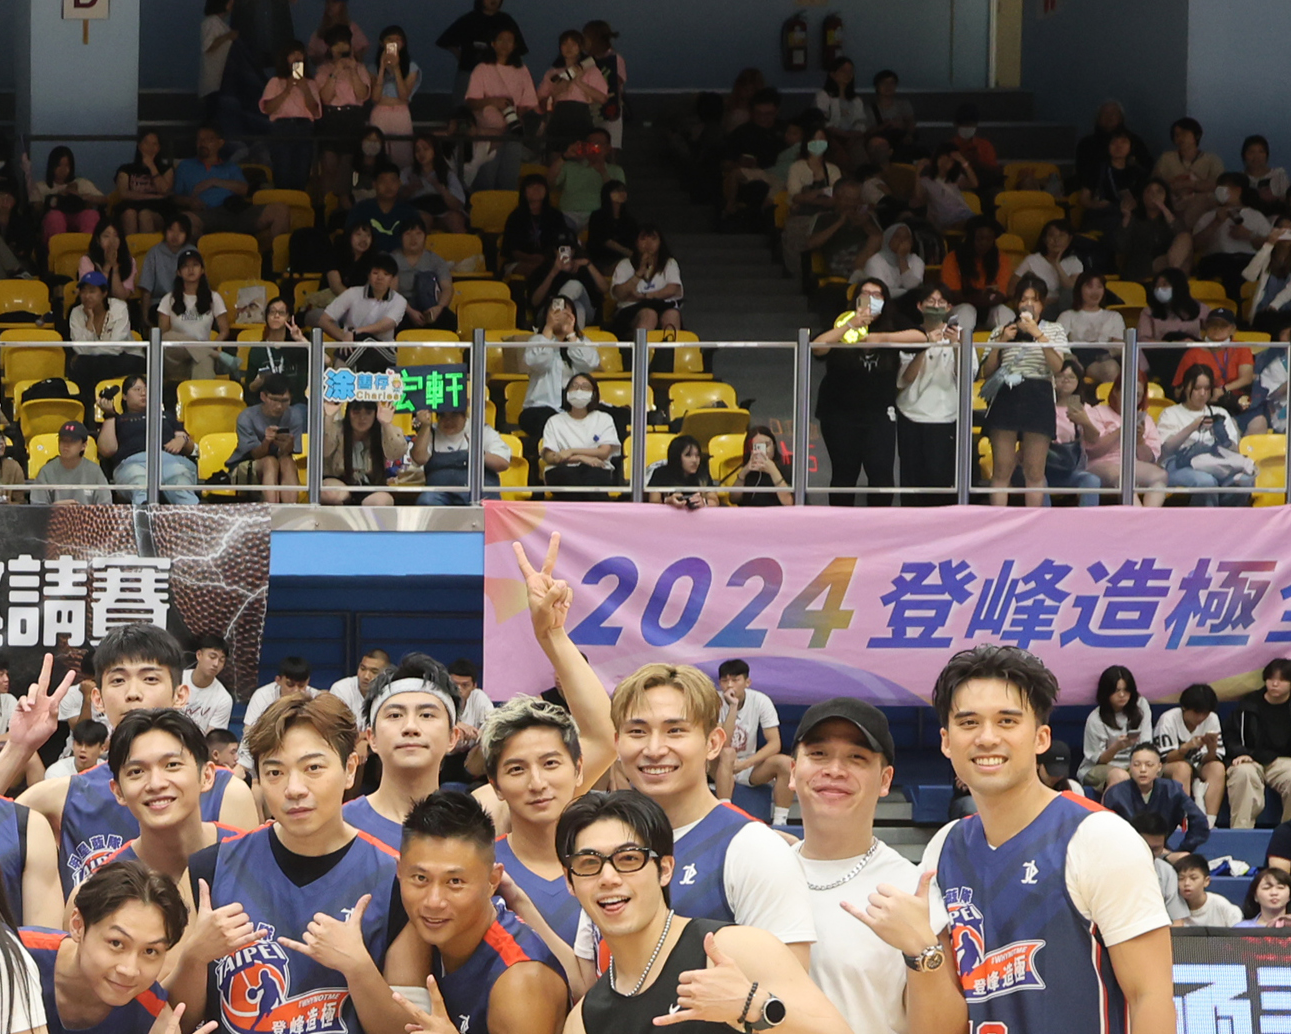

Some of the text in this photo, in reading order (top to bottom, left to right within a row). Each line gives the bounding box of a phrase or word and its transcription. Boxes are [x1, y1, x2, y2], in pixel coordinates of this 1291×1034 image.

[569, 554, 858, 649] 2024
[948, 904, 982, 924] PEI
[217, 939, 284, 985] TAIPEI
[972, 954, 1028, 996] 登峰造極
